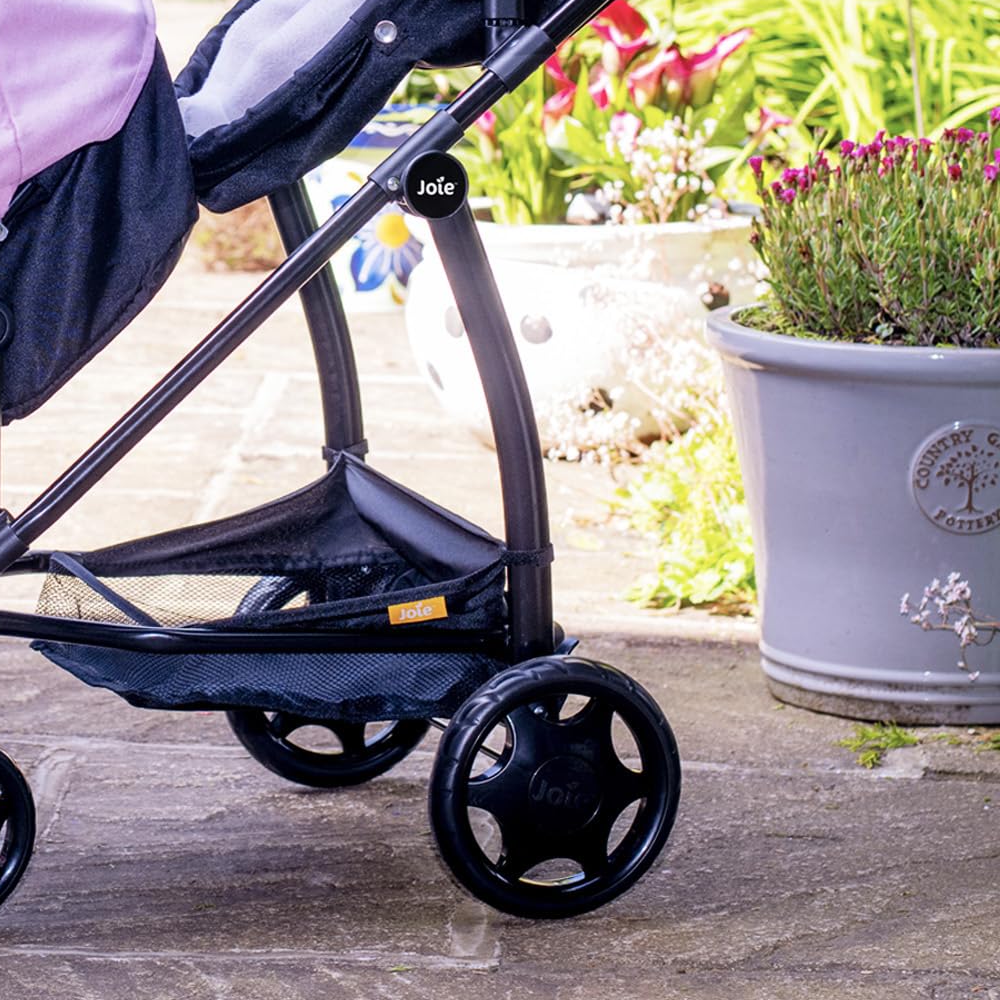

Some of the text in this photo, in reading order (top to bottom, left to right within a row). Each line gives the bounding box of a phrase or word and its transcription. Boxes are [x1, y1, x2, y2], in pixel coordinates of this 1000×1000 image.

[417, 176, 455, 195] Joie
[915, 429, 974, 489] COUNTRY
[399, 602, 433, 620] Joie
